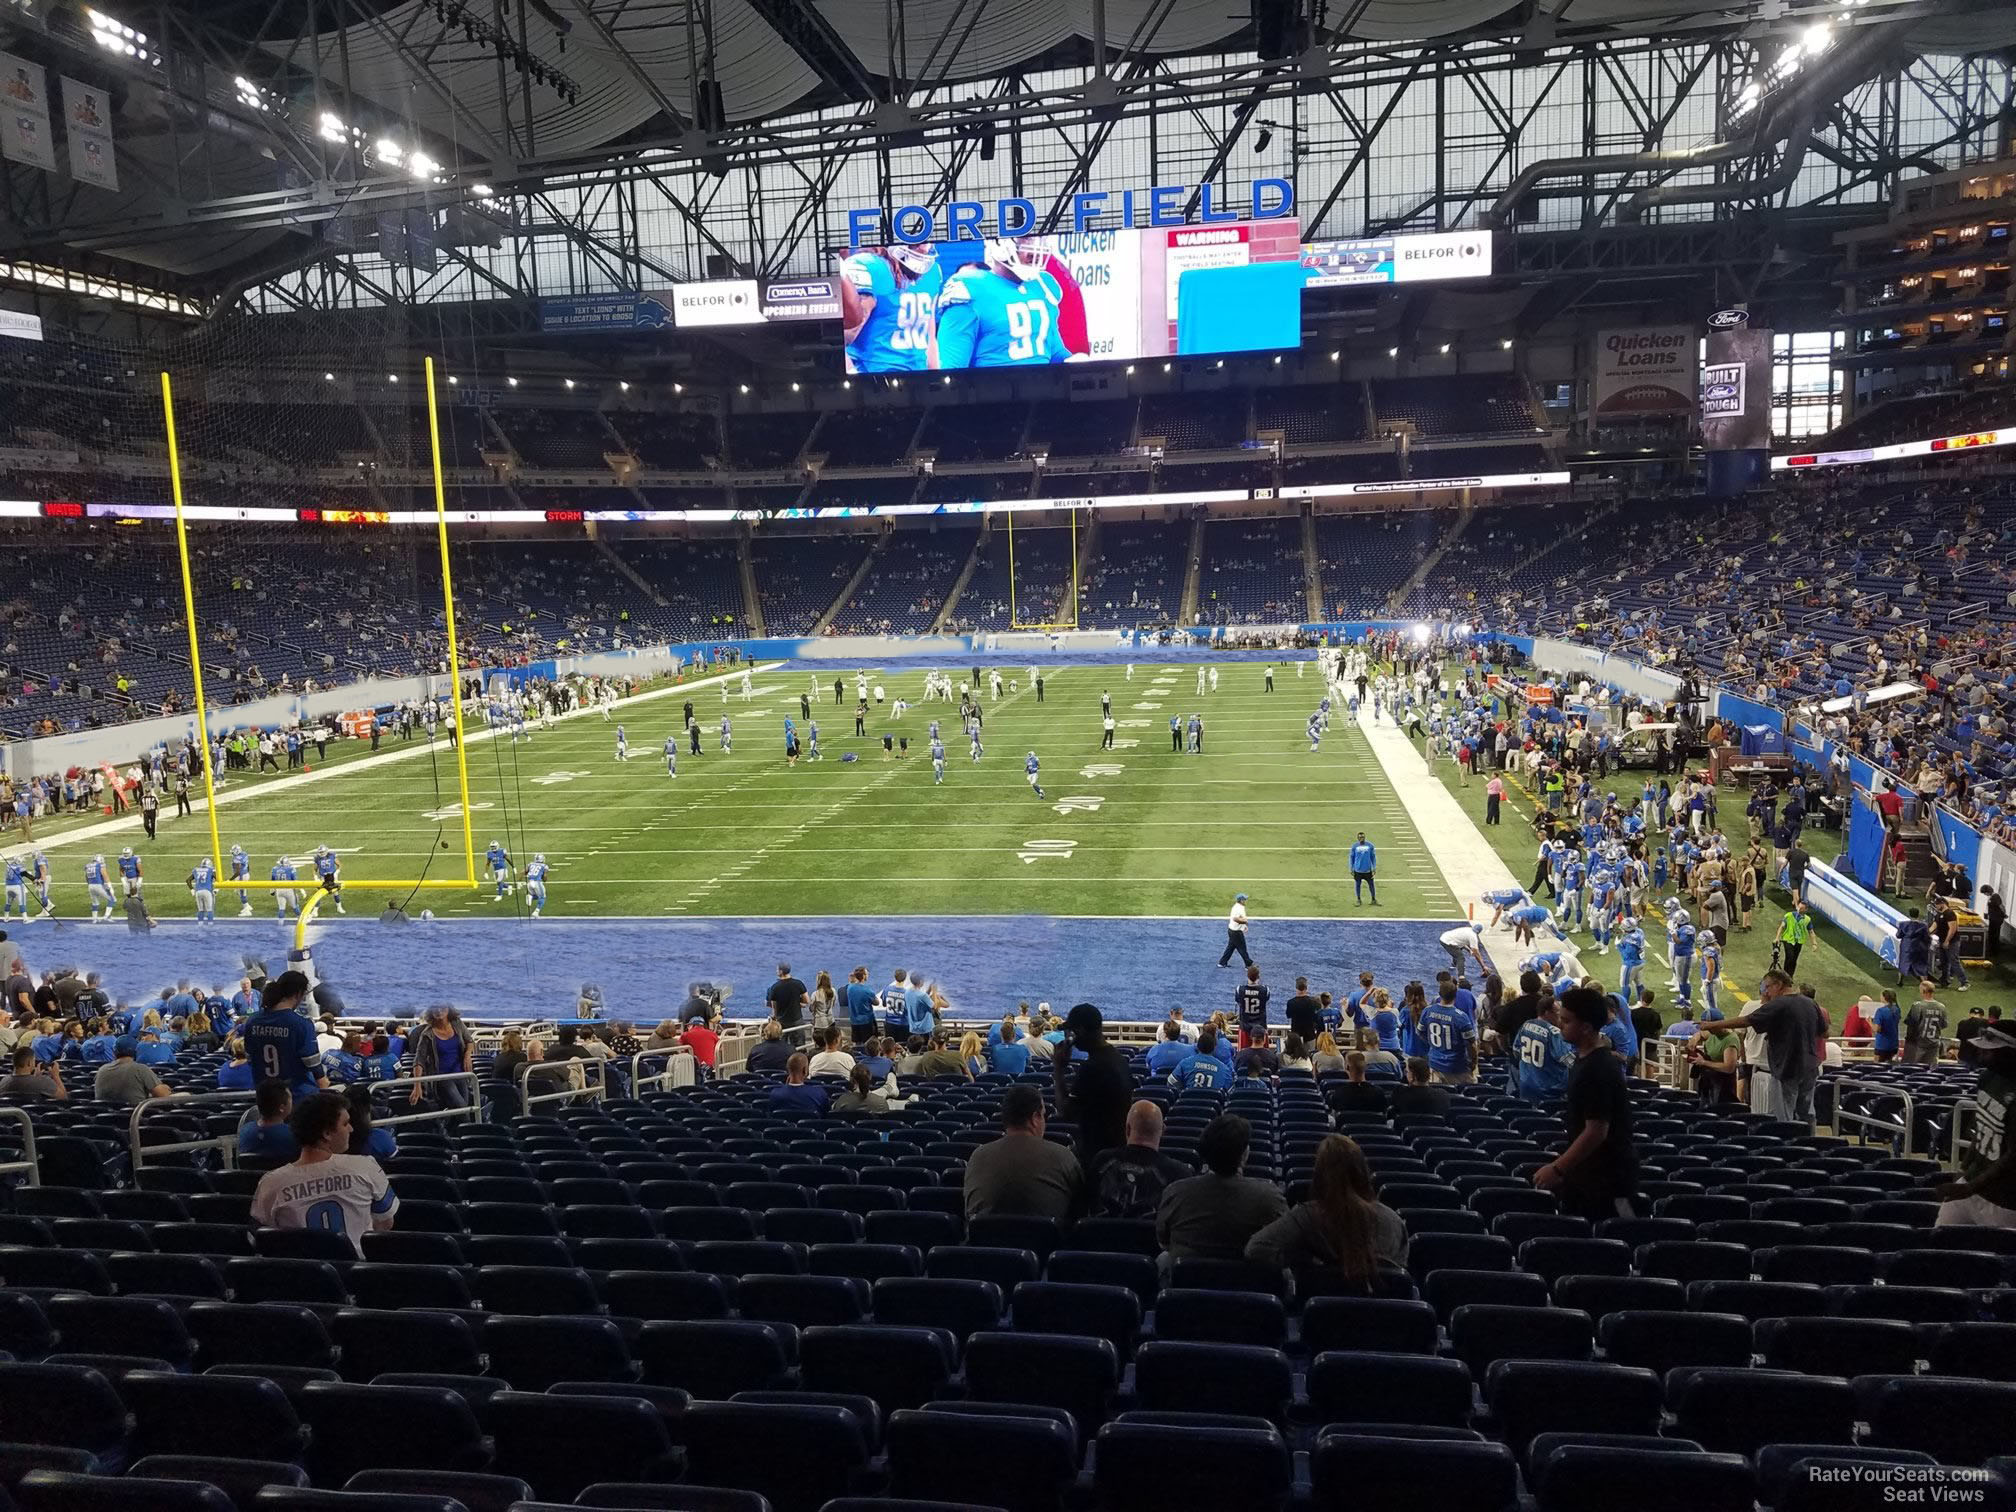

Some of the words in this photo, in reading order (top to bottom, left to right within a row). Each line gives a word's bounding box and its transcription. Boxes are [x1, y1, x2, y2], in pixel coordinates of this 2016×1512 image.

[848, 197, 1036, 248] FORD
[1073, 177, 1294, 233] FIELD
[1058, 231, 1116, 256] Quicken
[1176, 230, 1239, 246] WARNING
[1405, 248, 1454, 260] BELFOR
[807, 285, 828, 295] Bank
[617, 304, 634, 312] WITH
[682, 296, 725, 307] BELFOR
[763, 304, 807, 317] UPCOMING
[809, 303, 839, 314] EVENTS
[570, 314, 601, 323] LOCATION
[1714, 311, 1740, 324] Ford
[1006, 300, 1050, 360] 97
[1088, 337, 1114, 354] ead
[1606, 333, 1685, 352] Quicken
[1617, 352, 1677, 366] Loans
[1706, 369, 1739, 384] BUILT
[1711, 386, 1730, 396] Ford
[1706, 399, 1738, 412] TOUGH
[548, 511, 582, 520] STORM
[1244, 997, 1260, 1014] 12
[1428, 1011, 1452, 1022] JOHNSON
[252, 1025, 289, 1038] STAFFORD
[1922, 1018, 1939, 1039] 15
[1429, 1022, 1452, 1050] 81
[1520, 1035, 1545, 1068] 20
[263, 1044, 279, 1078] 9
[1194, 1061, 1218, 1072] JOHNSON
[1194, 1073, 1213, 1088] 81
[282, 1174, 352, 1201] STAFFORD
